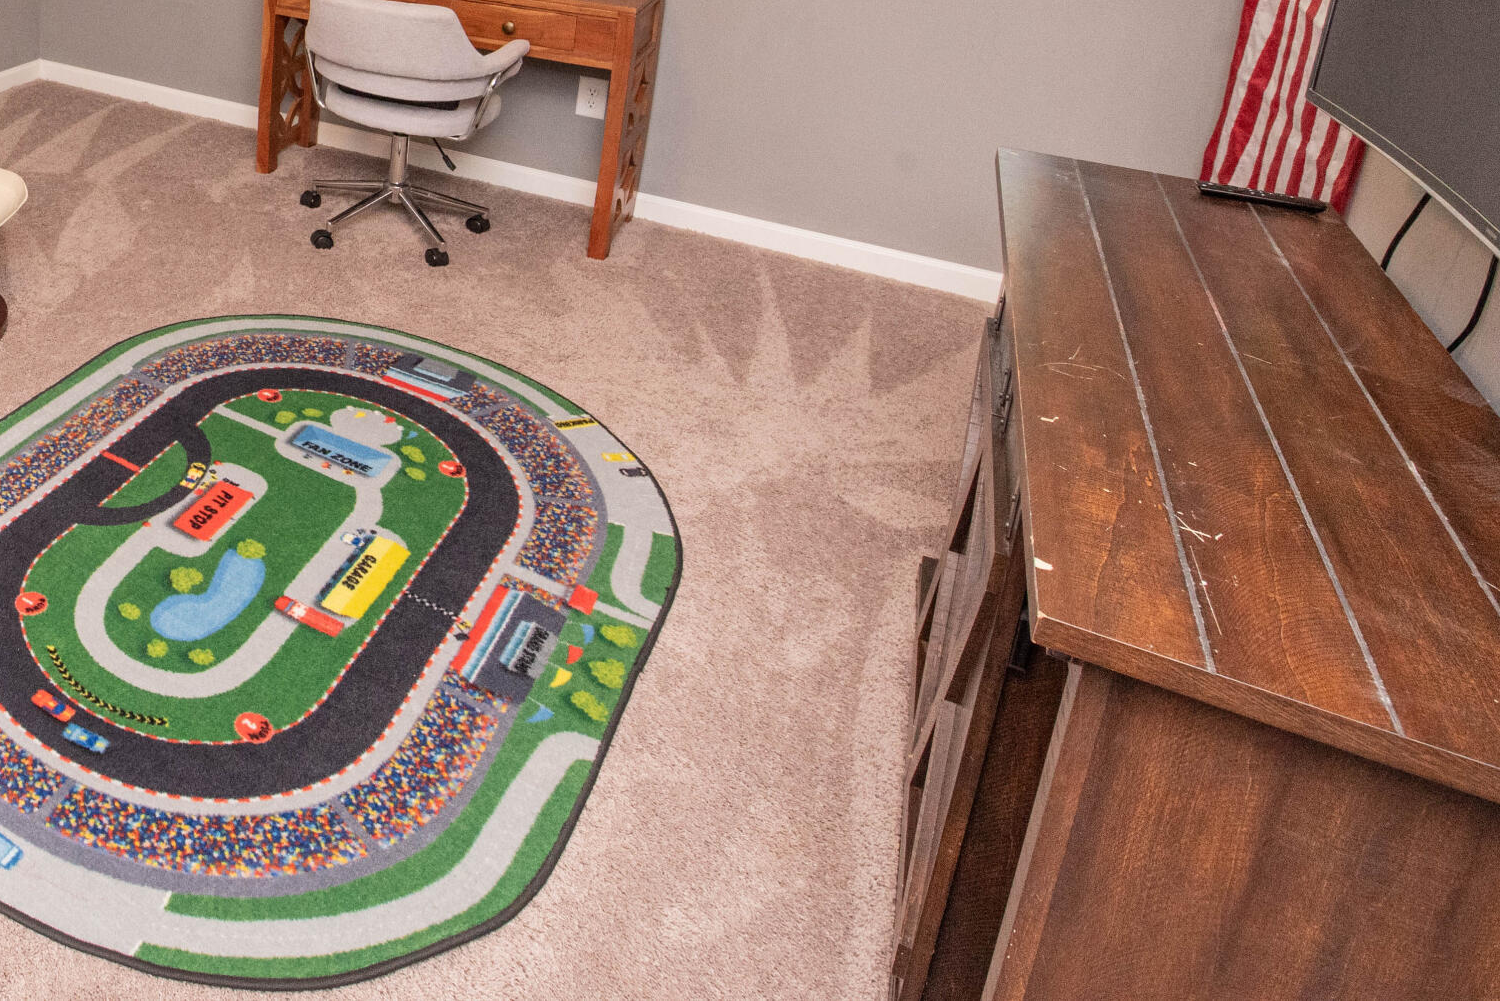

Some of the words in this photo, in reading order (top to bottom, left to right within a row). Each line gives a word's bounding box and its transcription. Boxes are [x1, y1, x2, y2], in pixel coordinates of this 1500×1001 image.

[301, 440, 332, 459] FAN
[331, 450, 374, 474] ZONE
[216, 489, 234, 509] PIT
[190, 504, 219, 531] STOP
[341, 554, 378, 591] GARAGE
